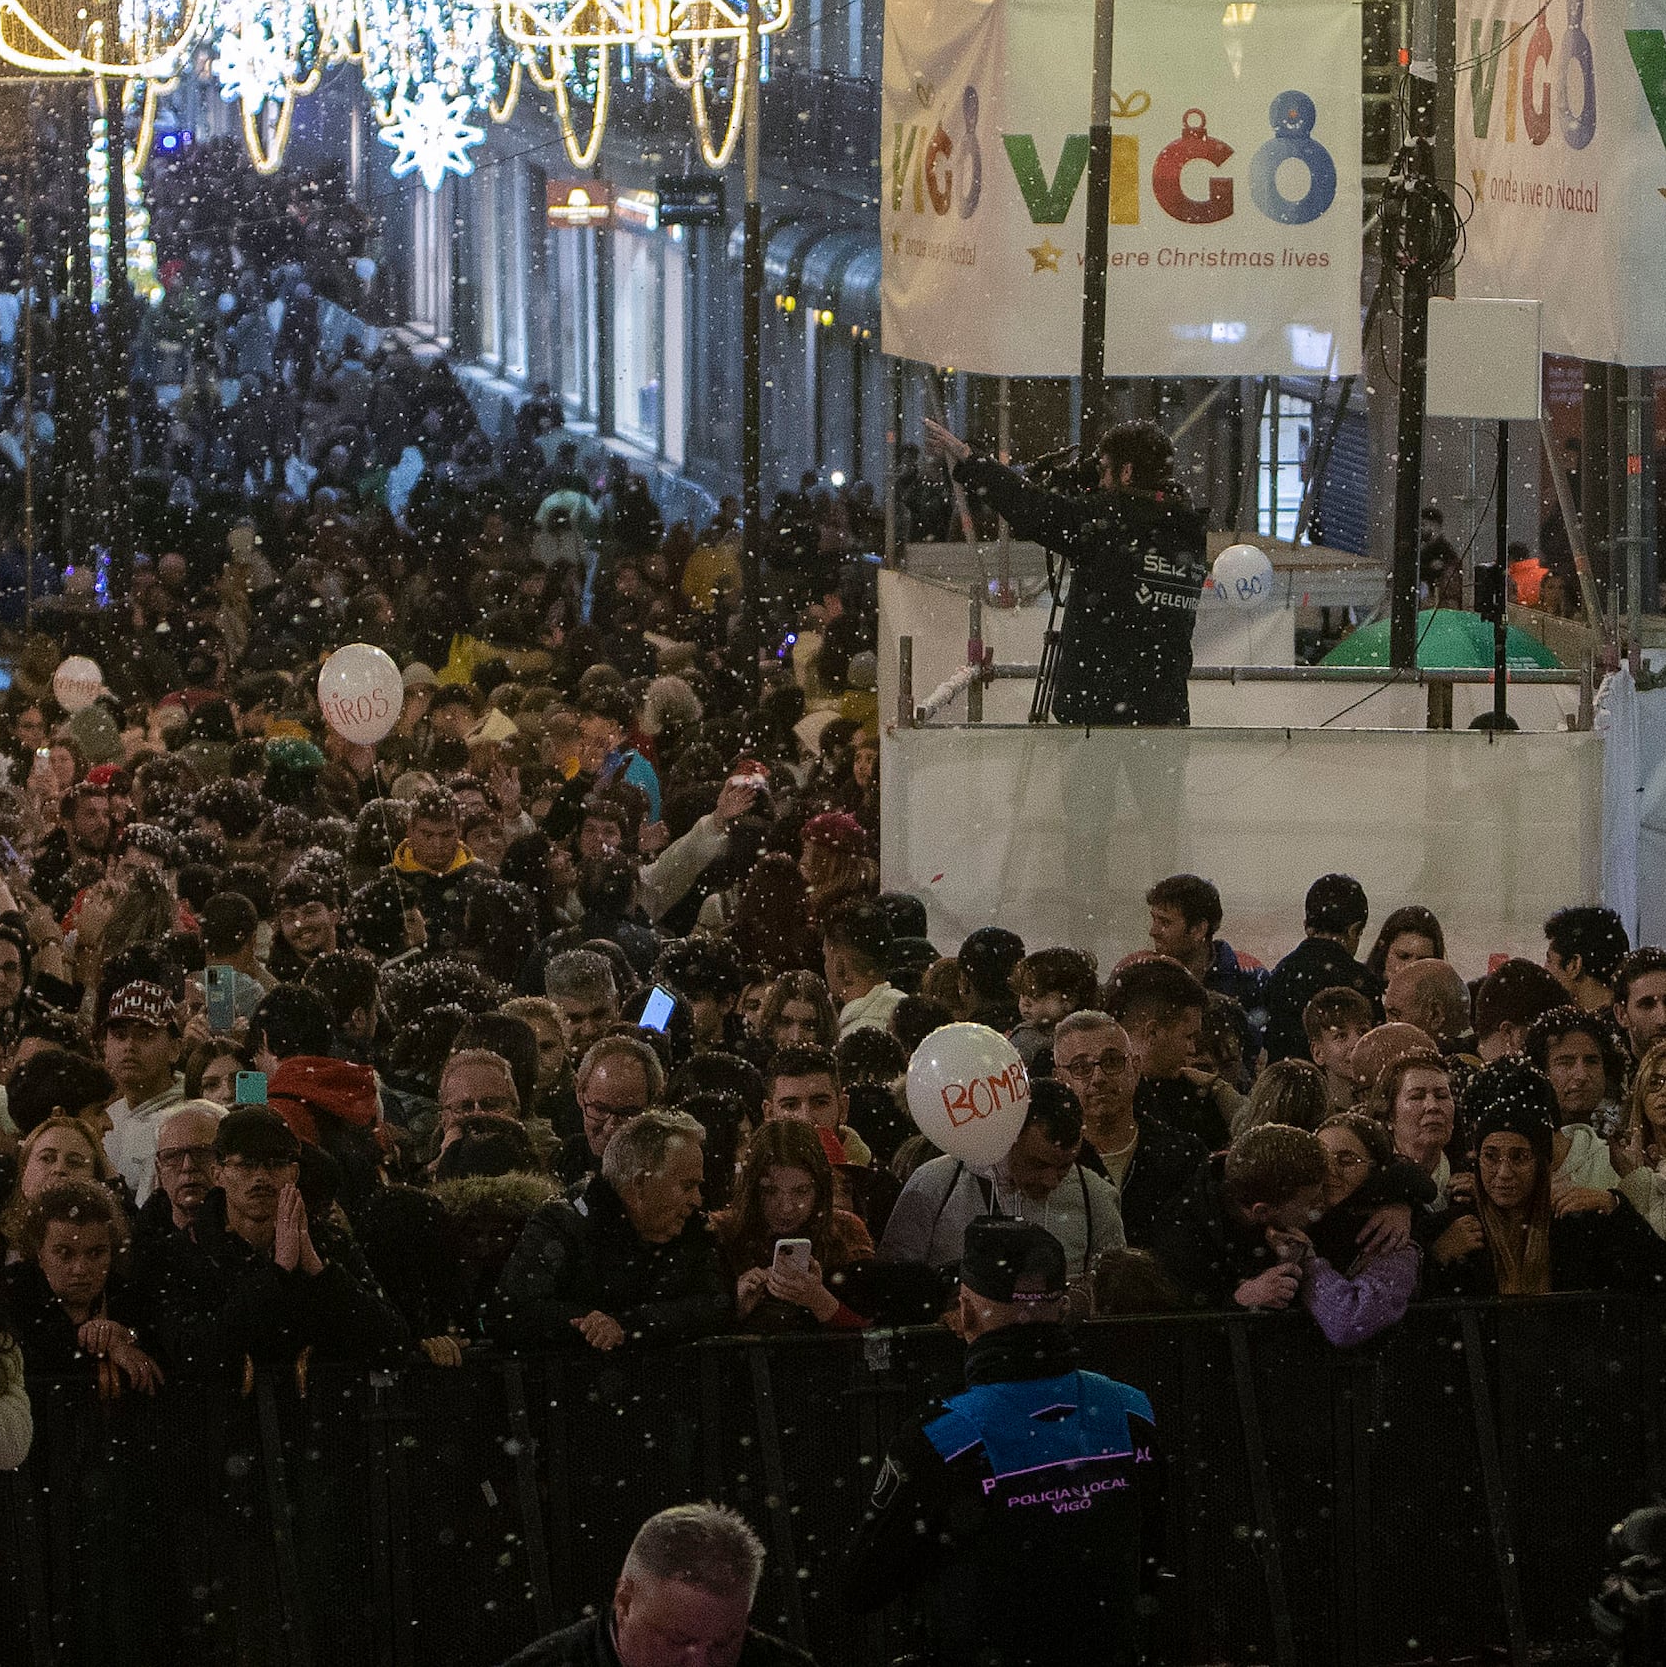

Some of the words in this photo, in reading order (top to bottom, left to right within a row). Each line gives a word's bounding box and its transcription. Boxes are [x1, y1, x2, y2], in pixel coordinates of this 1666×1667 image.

[1002, 91, 1336, 225] VIGO
[1491, 171, 1518, 203] onde
[1520, 180, 1544, 208] vive
[1556, 182, 1598, 213] Nadal
[1157, 247, 1274, 267] Christmas
[1282, 248, 1330, 267] lives
[1052, 1498, 1093, 1515] VIGO
